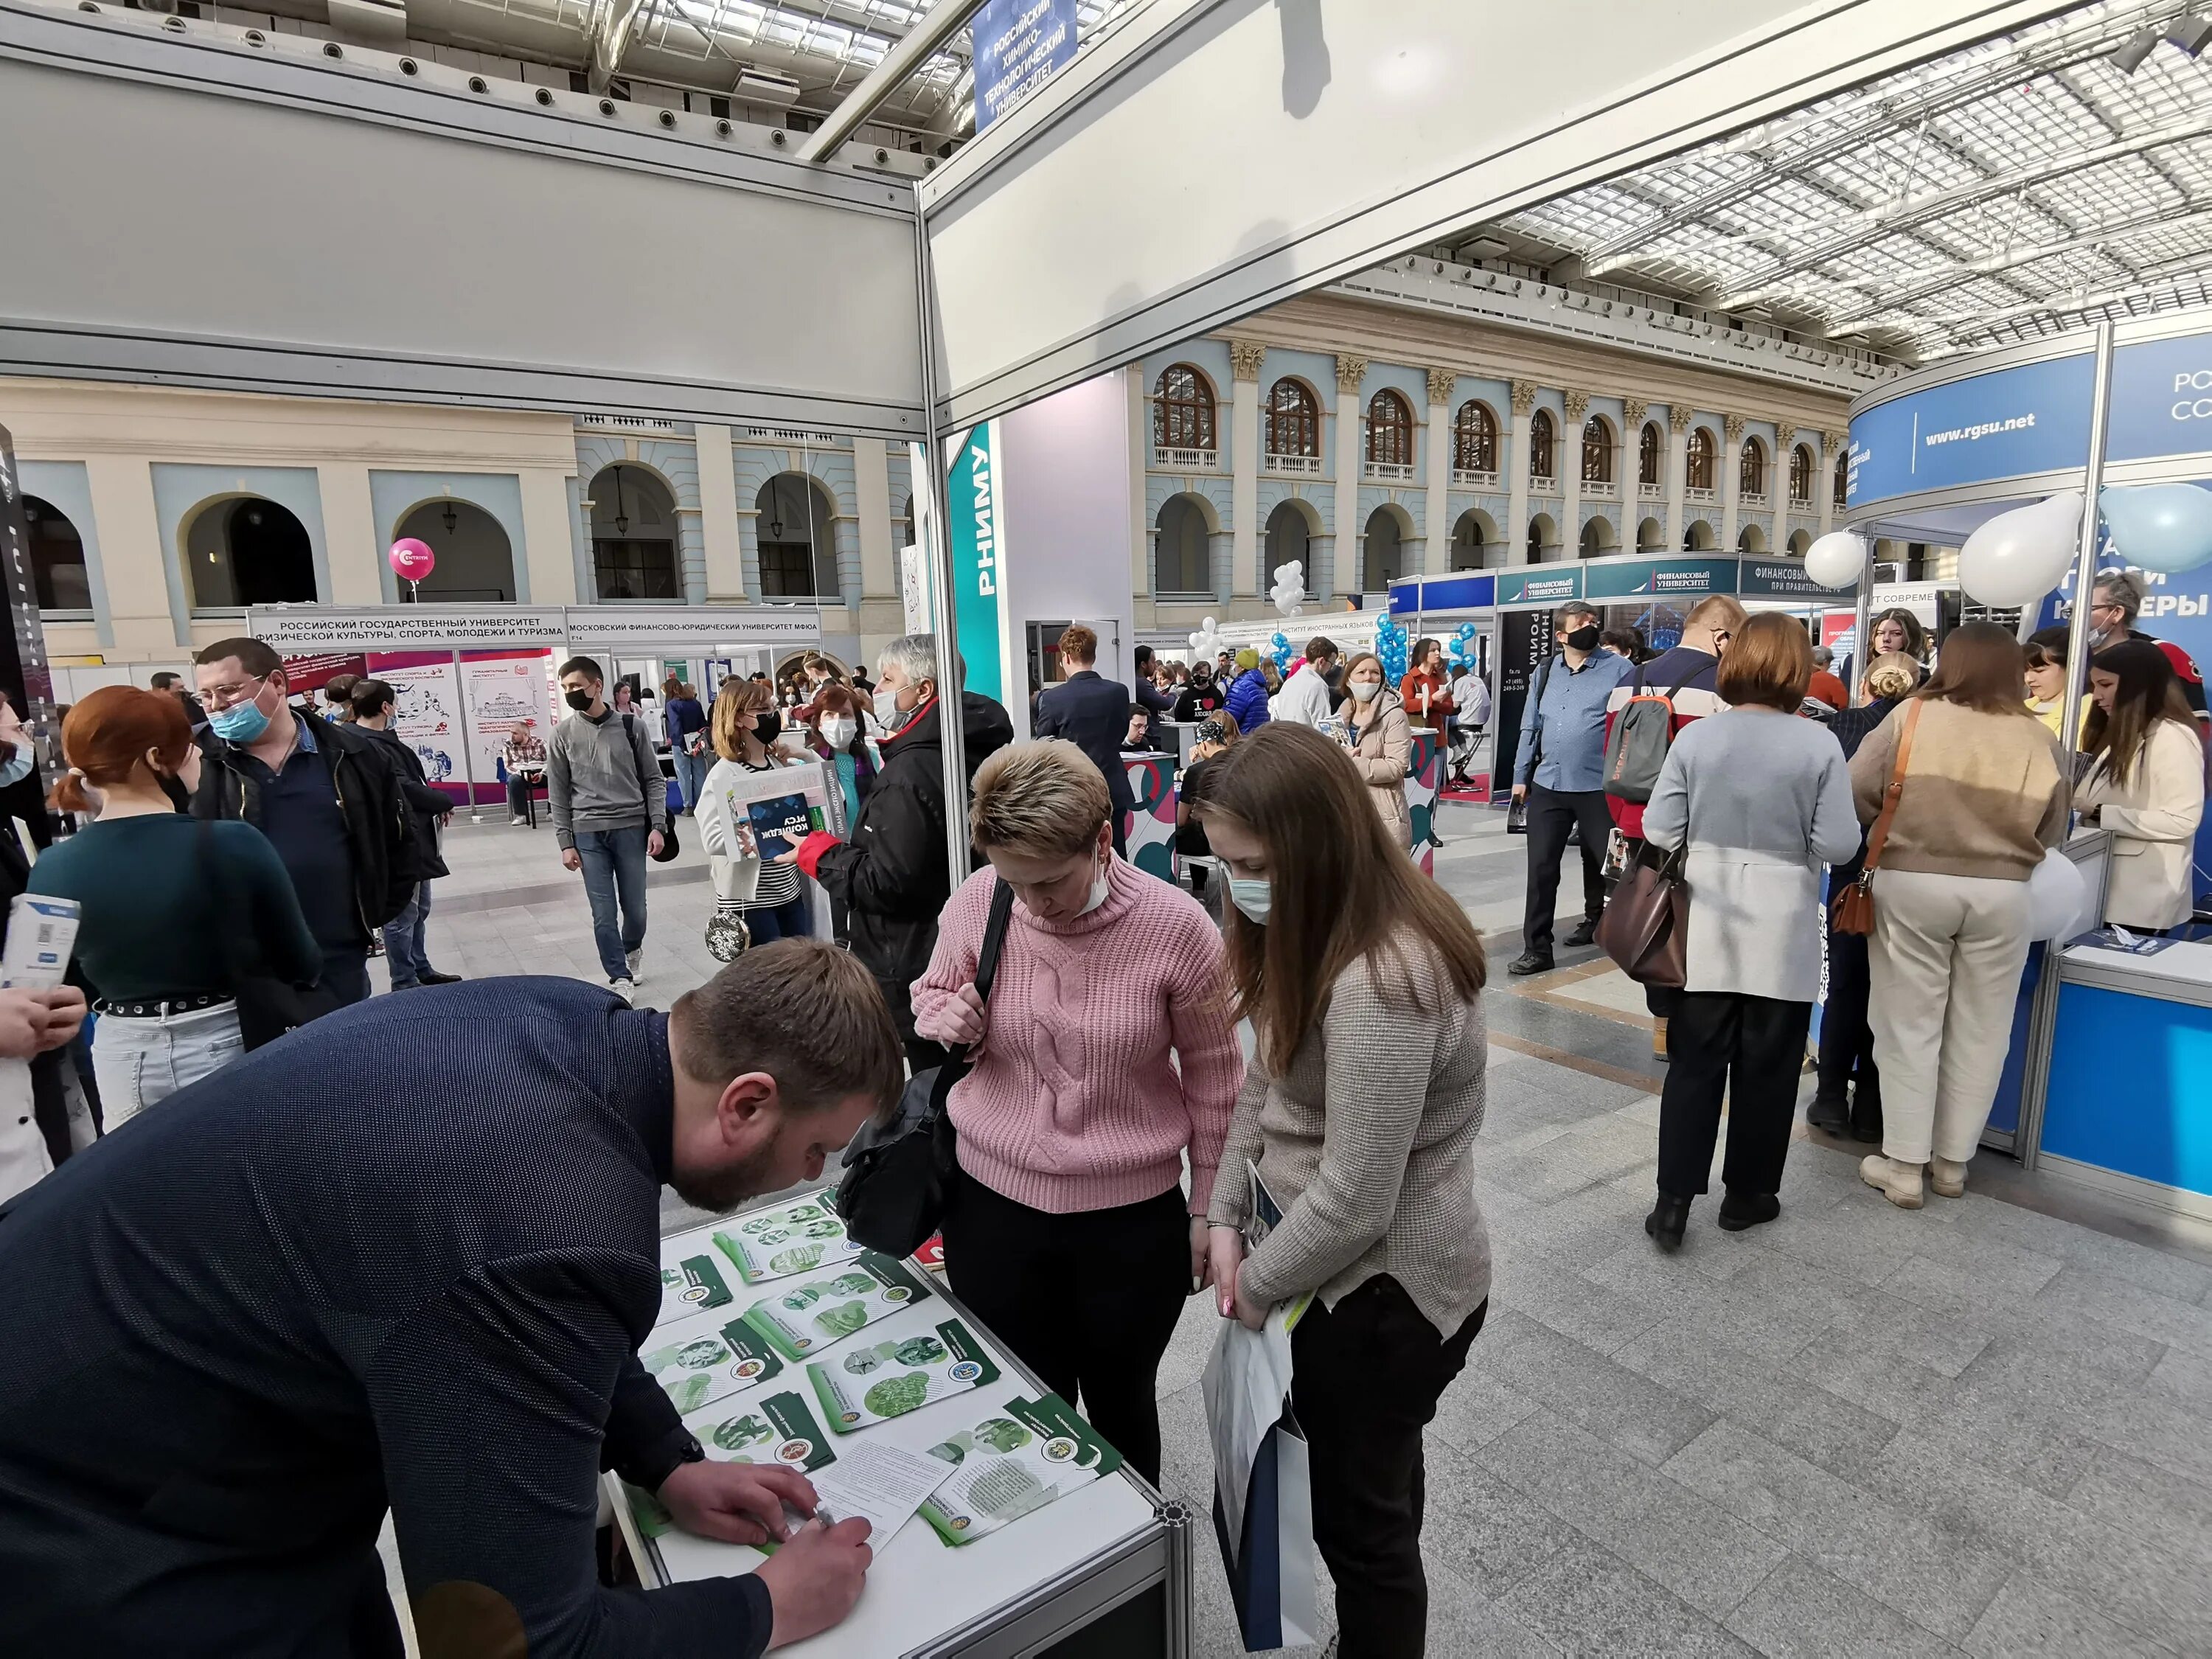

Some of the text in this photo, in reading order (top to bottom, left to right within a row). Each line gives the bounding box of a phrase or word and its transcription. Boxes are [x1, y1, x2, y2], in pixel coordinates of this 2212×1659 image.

[994, 0, 1050, 57] РОССИЙСКИЙ
[1003, 28, 1041, 70] ХИМИКО-
[984, 23, 1065, 106] ТЕХНОЛОГИЧЕСКИЙ
[995, 58, 1052, 117] УНИВЕРСИТЕТ
[1925, 413, 2035, 446] www.rgsu.net
[971, 445, 995, 596] РНИМУ
[1657, 571, 1710, 580] ФИНАНСОВЫЙ
[1528, 577, 1573, 589] ФИНАНСОВЫЙ
[1657, 580, 1710, 588] УНИВЕРСИТЕТ
[1771, 582, 1784, 591] ПРИ
[1528, 587, 1573, 597] УНИВЕРСИТЕТ
[1883, 593, 1937, 603] СОВРЕМЕ
[280, 618, 540, 630] РОССИЙСКИЙ ГОСУДАРСТВЕННЫЙ УНИВЕРСИТЕТ
[569, 623, 627, 631] МОСКОВСКИЙ
[628, 623, 740, 631] ФИНАНСОВО-ЮРИДИЧЕСКИЙ
[1307, 623, 1348, 632] ИНОСТРАННЫХ
[256, 631, 333, 641] ФИЗИЧЕСКОЙ
[337, 630, 397, 639] КУЛЬТУРЫ,
[399, 630, 444, 639] СПОРТА,
[447, 628, 507, 638] МОЛОДЕЖИ
[518, 627, 563, 636] ТУРИЗМА
[1193, 699, 1202, 711] I
[826, 769, 845, 834] ПЛАН ЭКСПОЗИЦИИ
[784, 814, 807, 826] РГСУ
